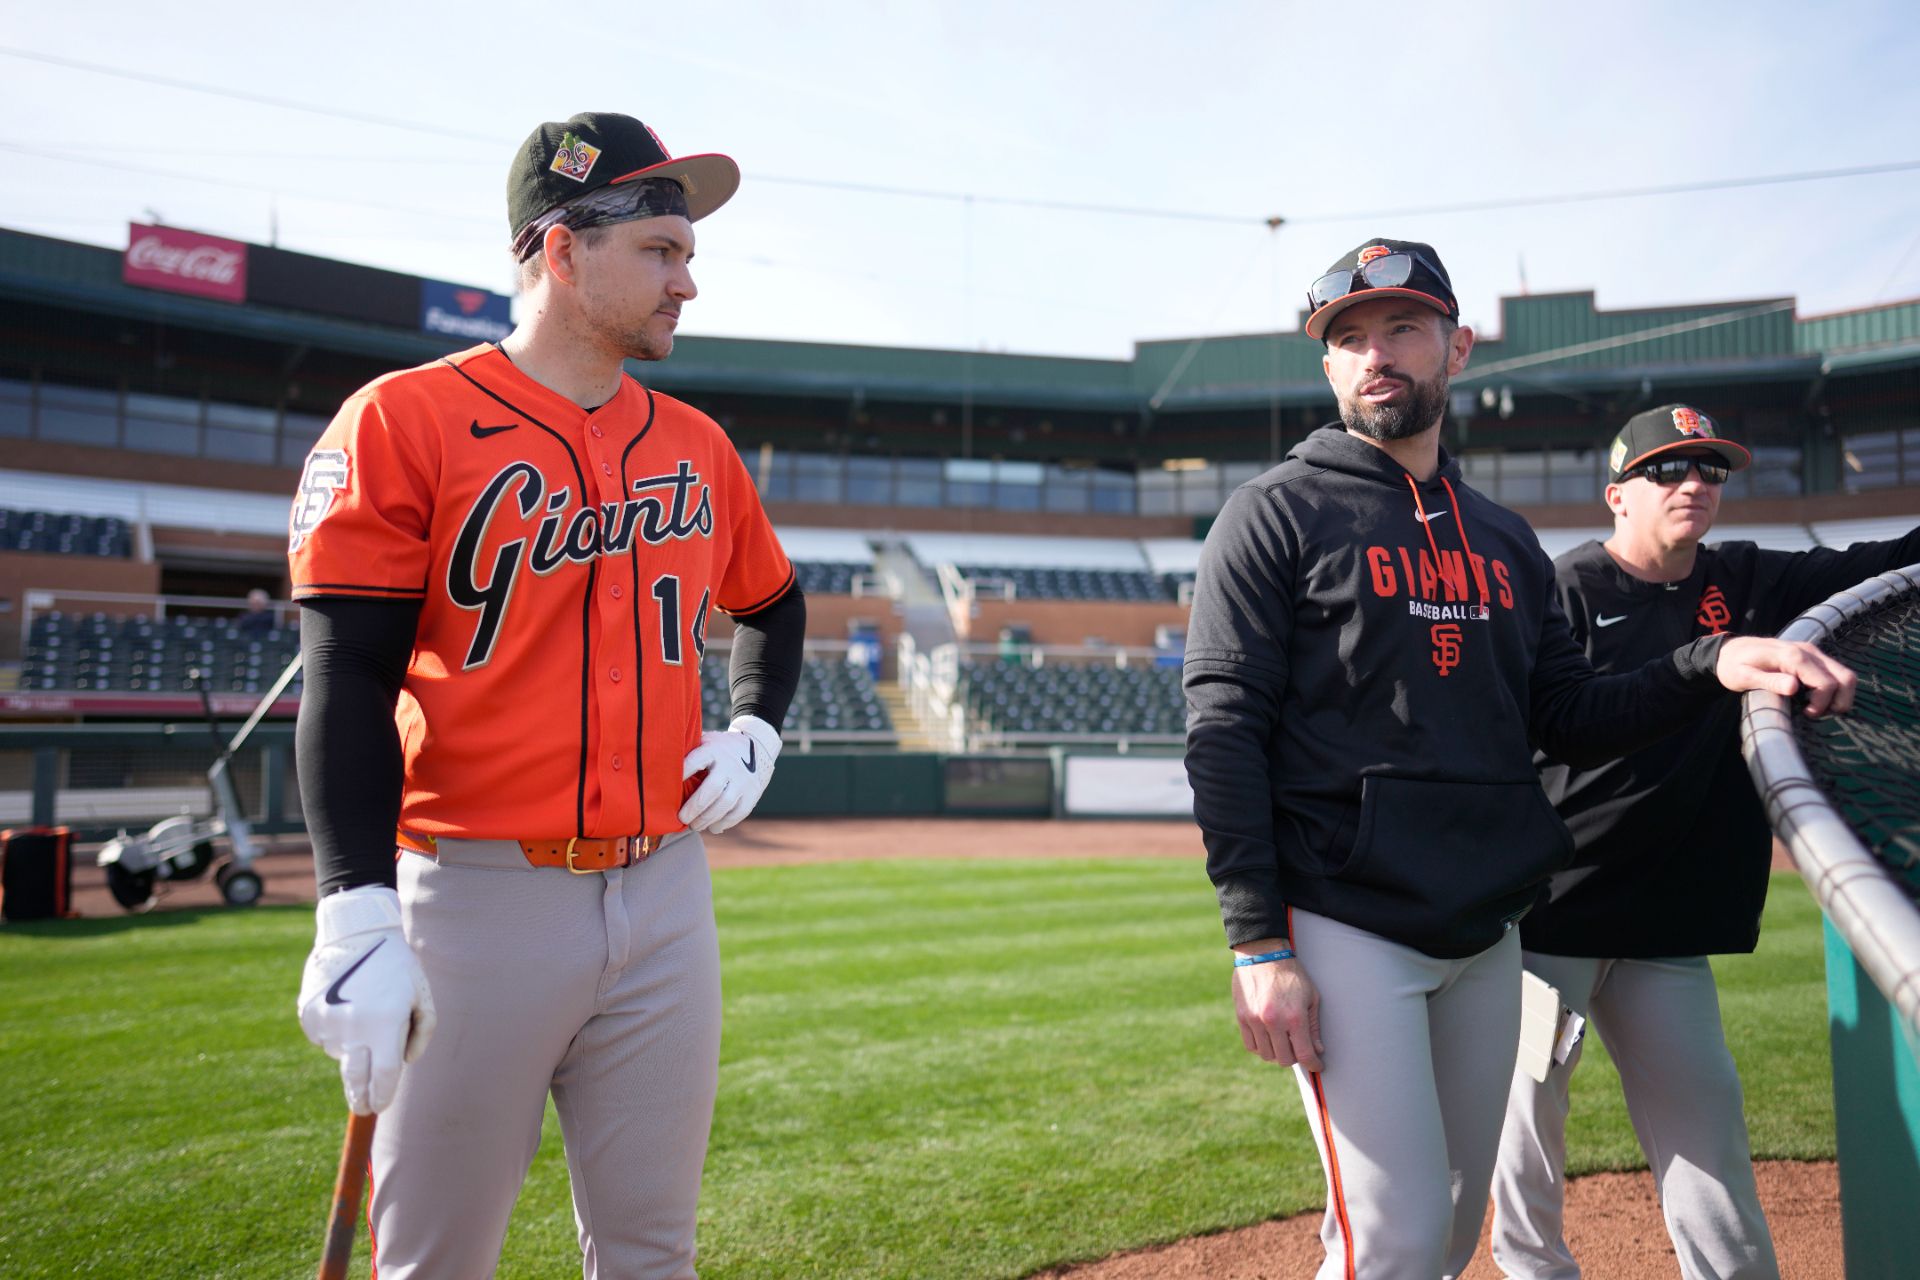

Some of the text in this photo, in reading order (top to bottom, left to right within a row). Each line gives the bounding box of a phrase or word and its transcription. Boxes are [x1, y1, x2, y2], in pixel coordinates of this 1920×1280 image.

[556, 142, 588, 171] 26
[446, 460, 713, 672] Giants
[1366, 546, 1514, 609] GIANTS
[1408, 600, 1467, 620] BASEBALL
